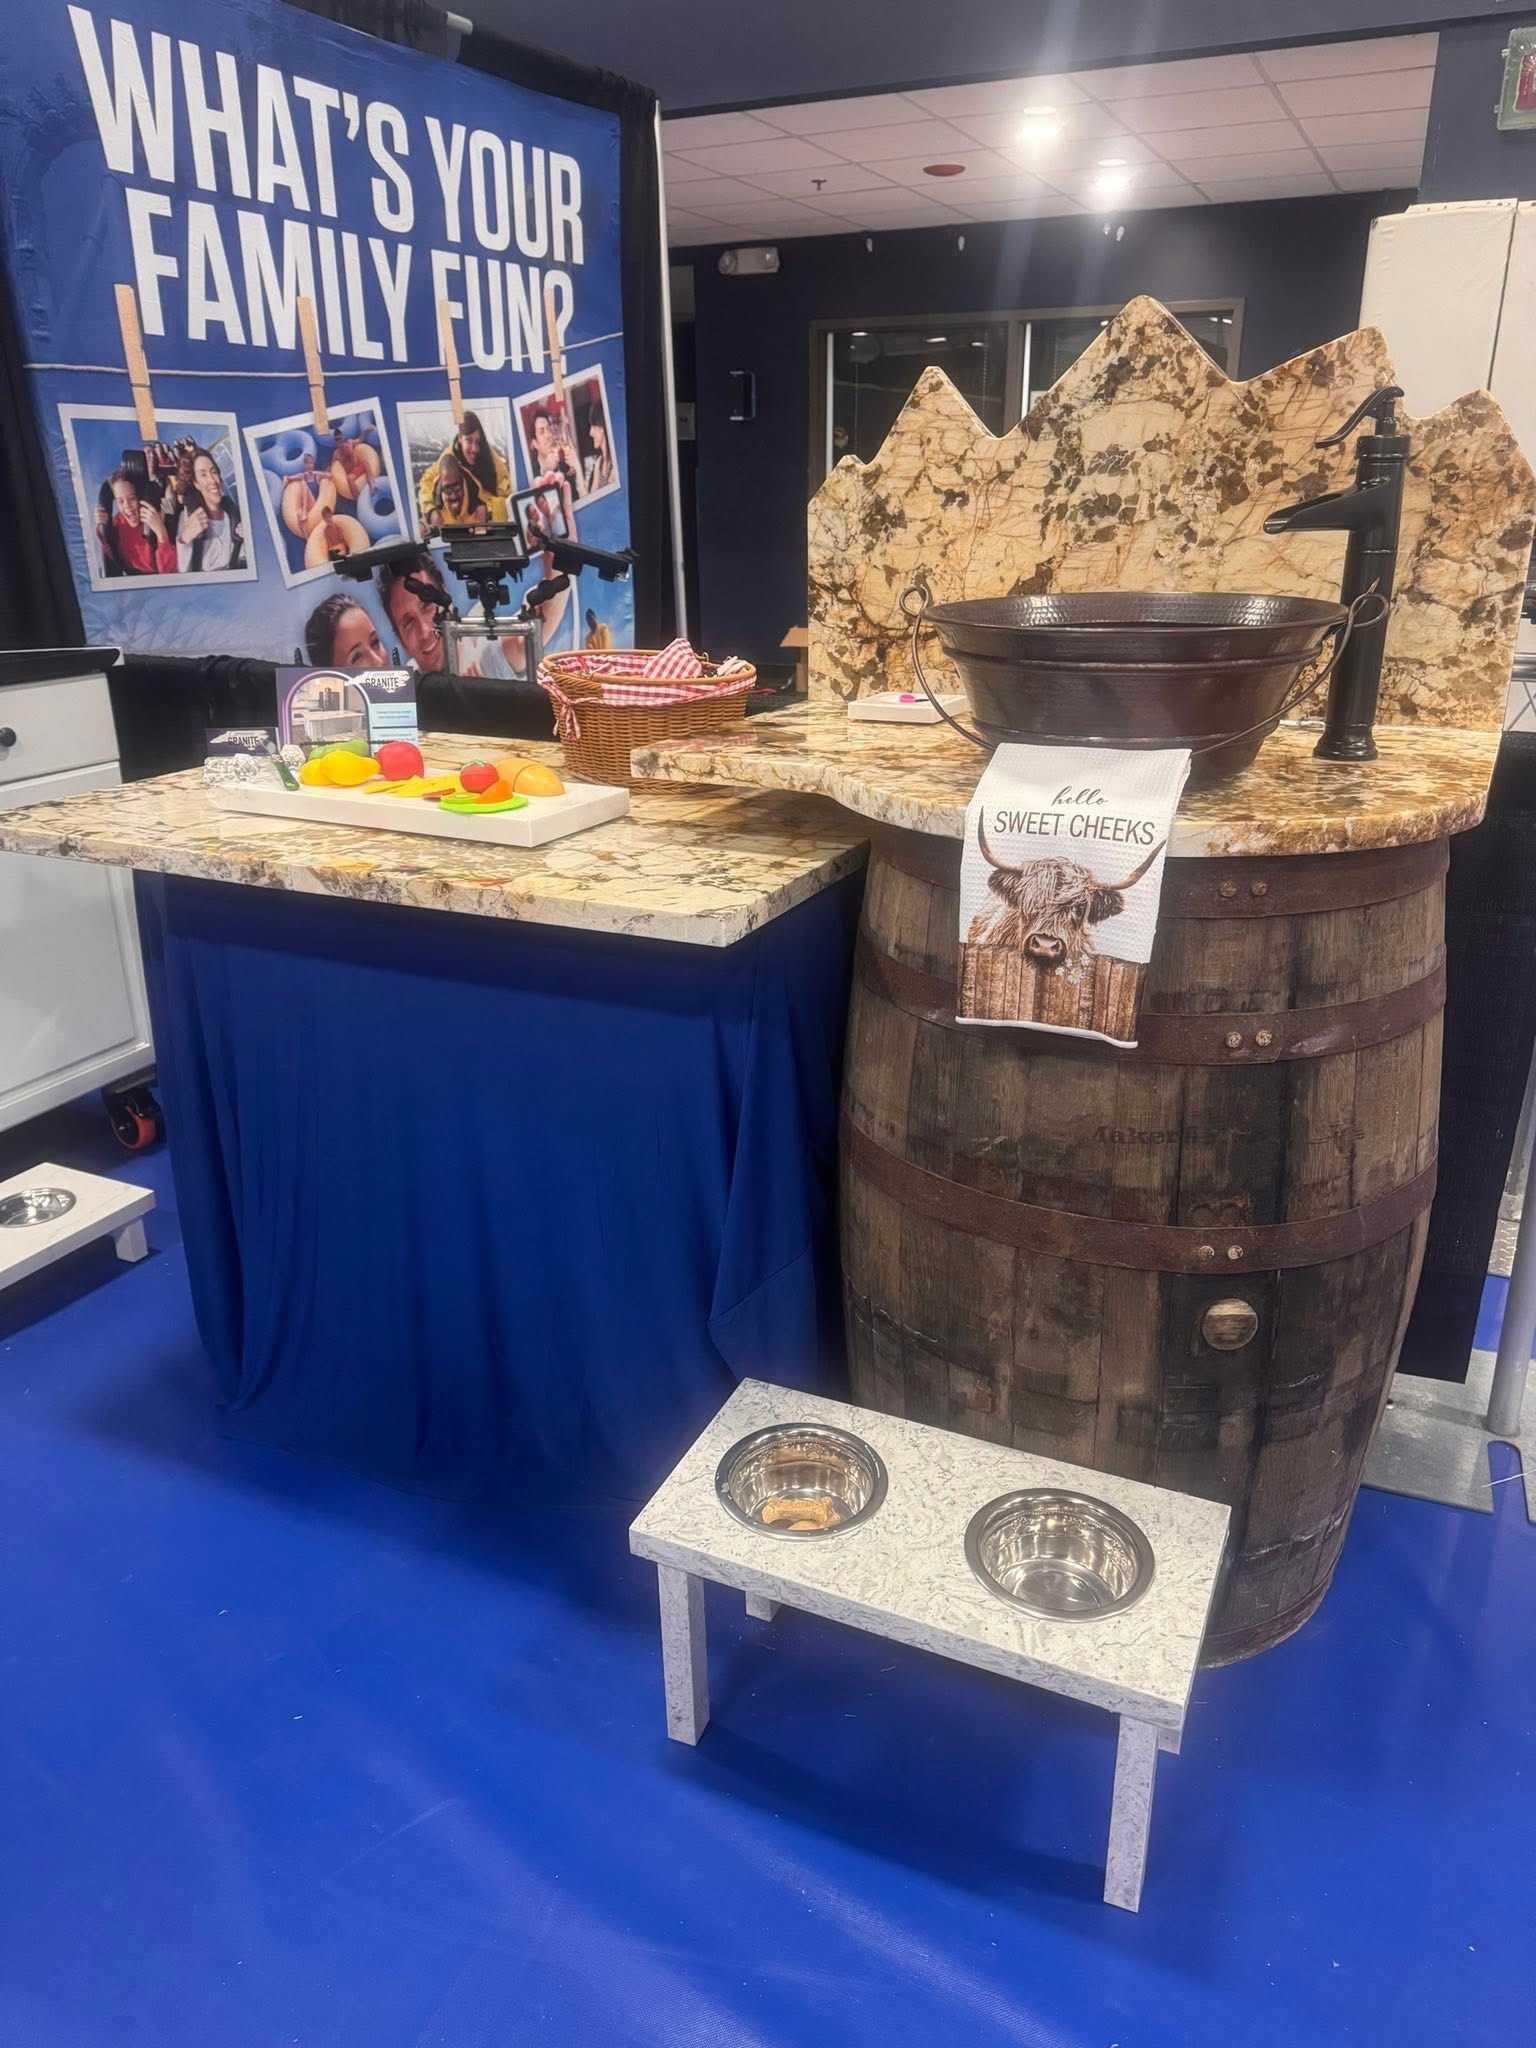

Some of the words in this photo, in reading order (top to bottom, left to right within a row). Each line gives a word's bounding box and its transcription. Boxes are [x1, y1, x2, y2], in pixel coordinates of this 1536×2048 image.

[67, 4, 415, 233] WHAT'S
[425, 115, 585, 265] YOUR
[124, 186, 413, 363] FAMILY
[431, 249, 574, 375] FUN?
[364, 676, 400, 689] GRANITE
[227, 735, 261, 747] GRANITE
[1050, 785, 1109, 807] hello
[993, 810, 1065, 837] SWEET
[1069, 814, 1156, 846] CHEEKS
